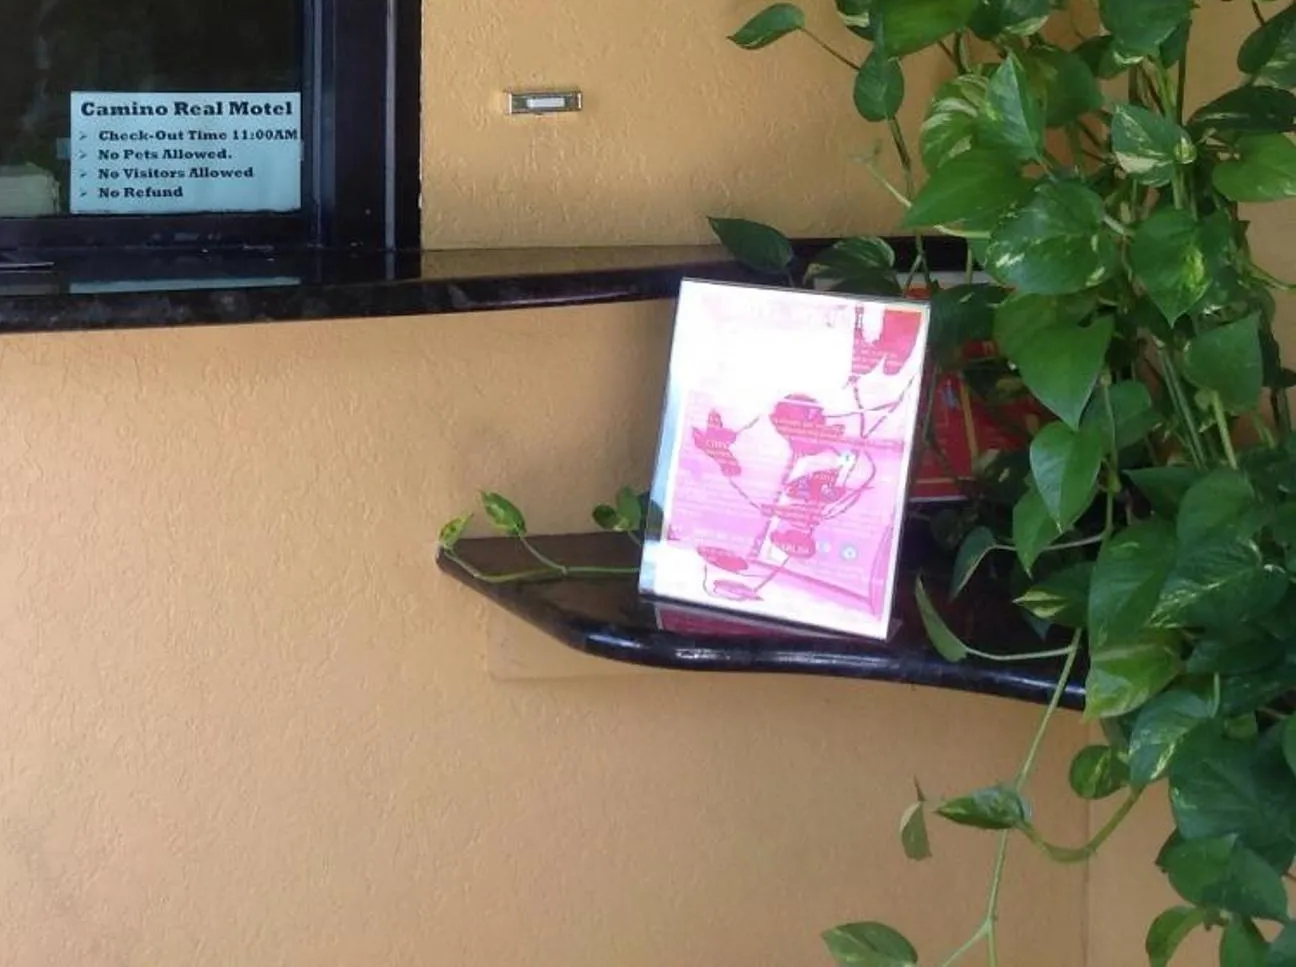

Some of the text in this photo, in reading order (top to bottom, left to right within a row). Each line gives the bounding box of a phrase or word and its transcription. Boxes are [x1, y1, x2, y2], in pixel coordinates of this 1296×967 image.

[81, 101, 292, 116] Camino Real Motel
[98, 129, 298, 141] Check-Out Time 11:00AM
[98, 150, 119, 160] No
[124, 149, 158, 160] Pets
[98, 167, 253, 179] No Visitors Allowed
[98, 186, 184, 198] No Refund
